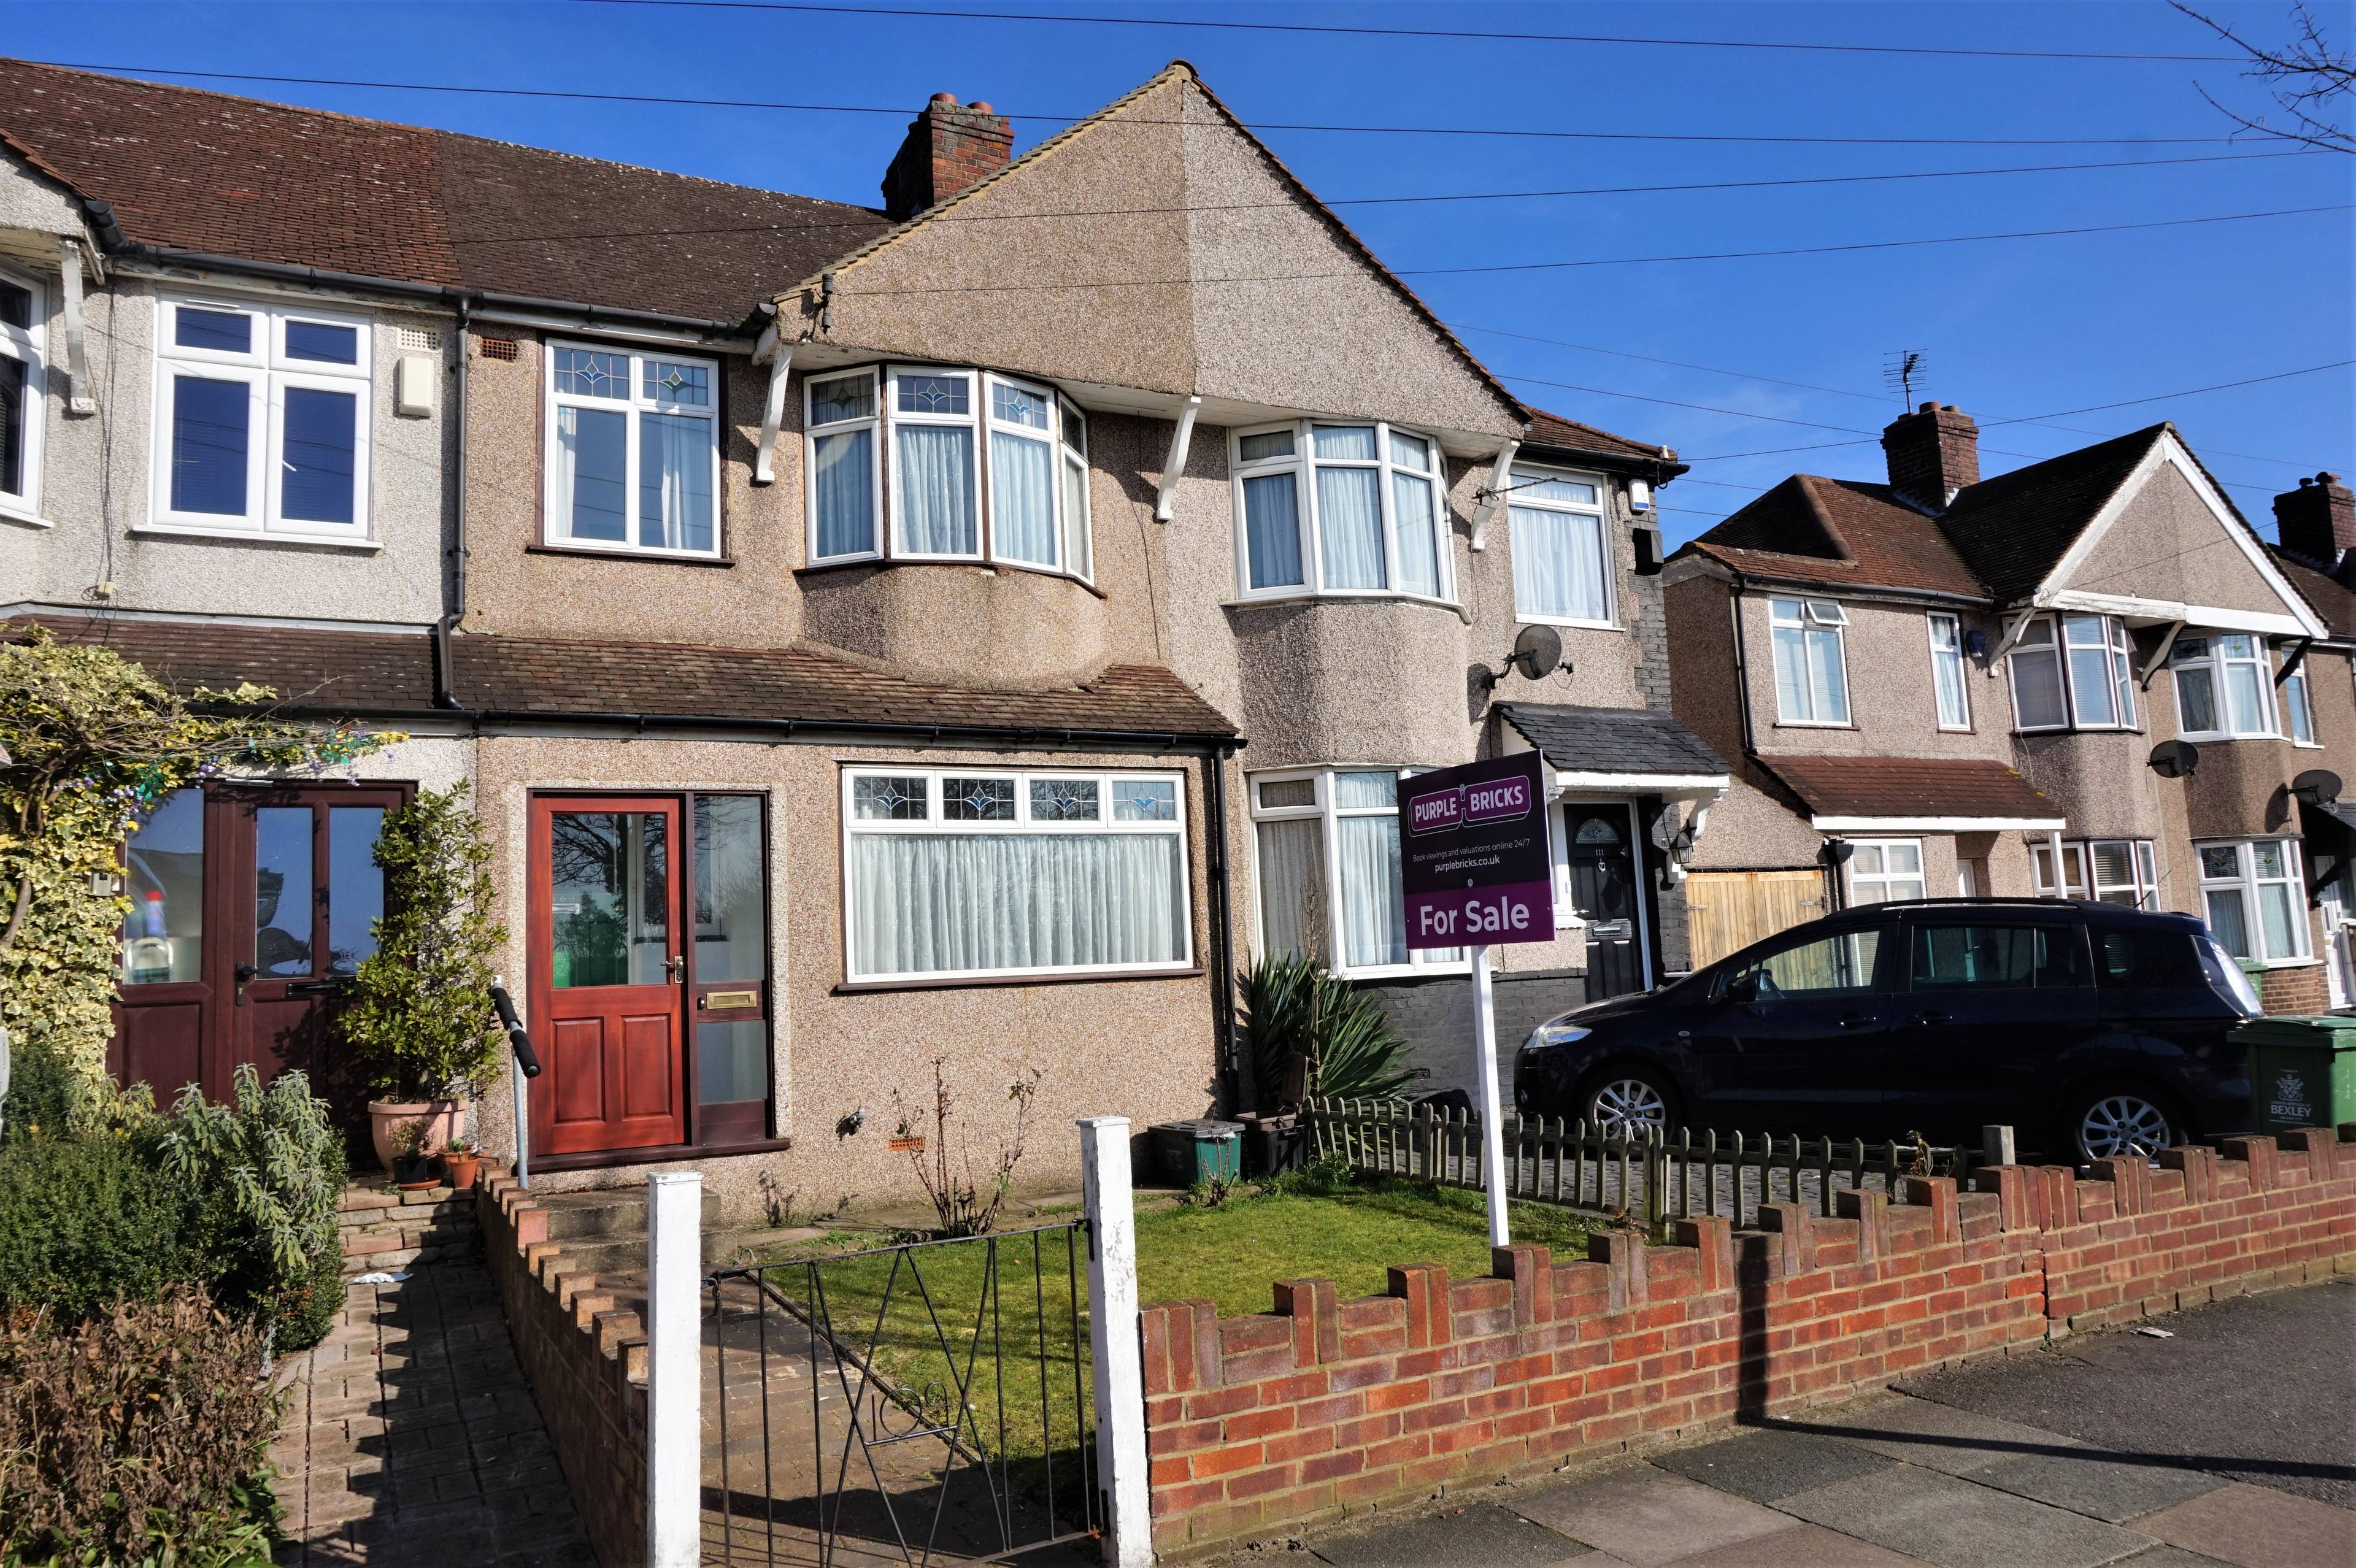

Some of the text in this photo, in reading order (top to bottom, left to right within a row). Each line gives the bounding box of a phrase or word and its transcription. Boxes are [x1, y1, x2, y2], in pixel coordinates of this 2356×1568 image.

[1415, 785, 1523, 822] PURPLE BRICKS
[1426, 851, 1448, 860] viewings
[1460, 844, 1491, 855] valuations
[1492, 841, 1513, 850] online
[1514, 838, 1530, 848] 24/7
[1434, 855, 1501, 874] purplebricks.co.uk
[1420, 896, 1530, 936] For Sale
[2270, 1104, 2312, 1117] BEXLEY
